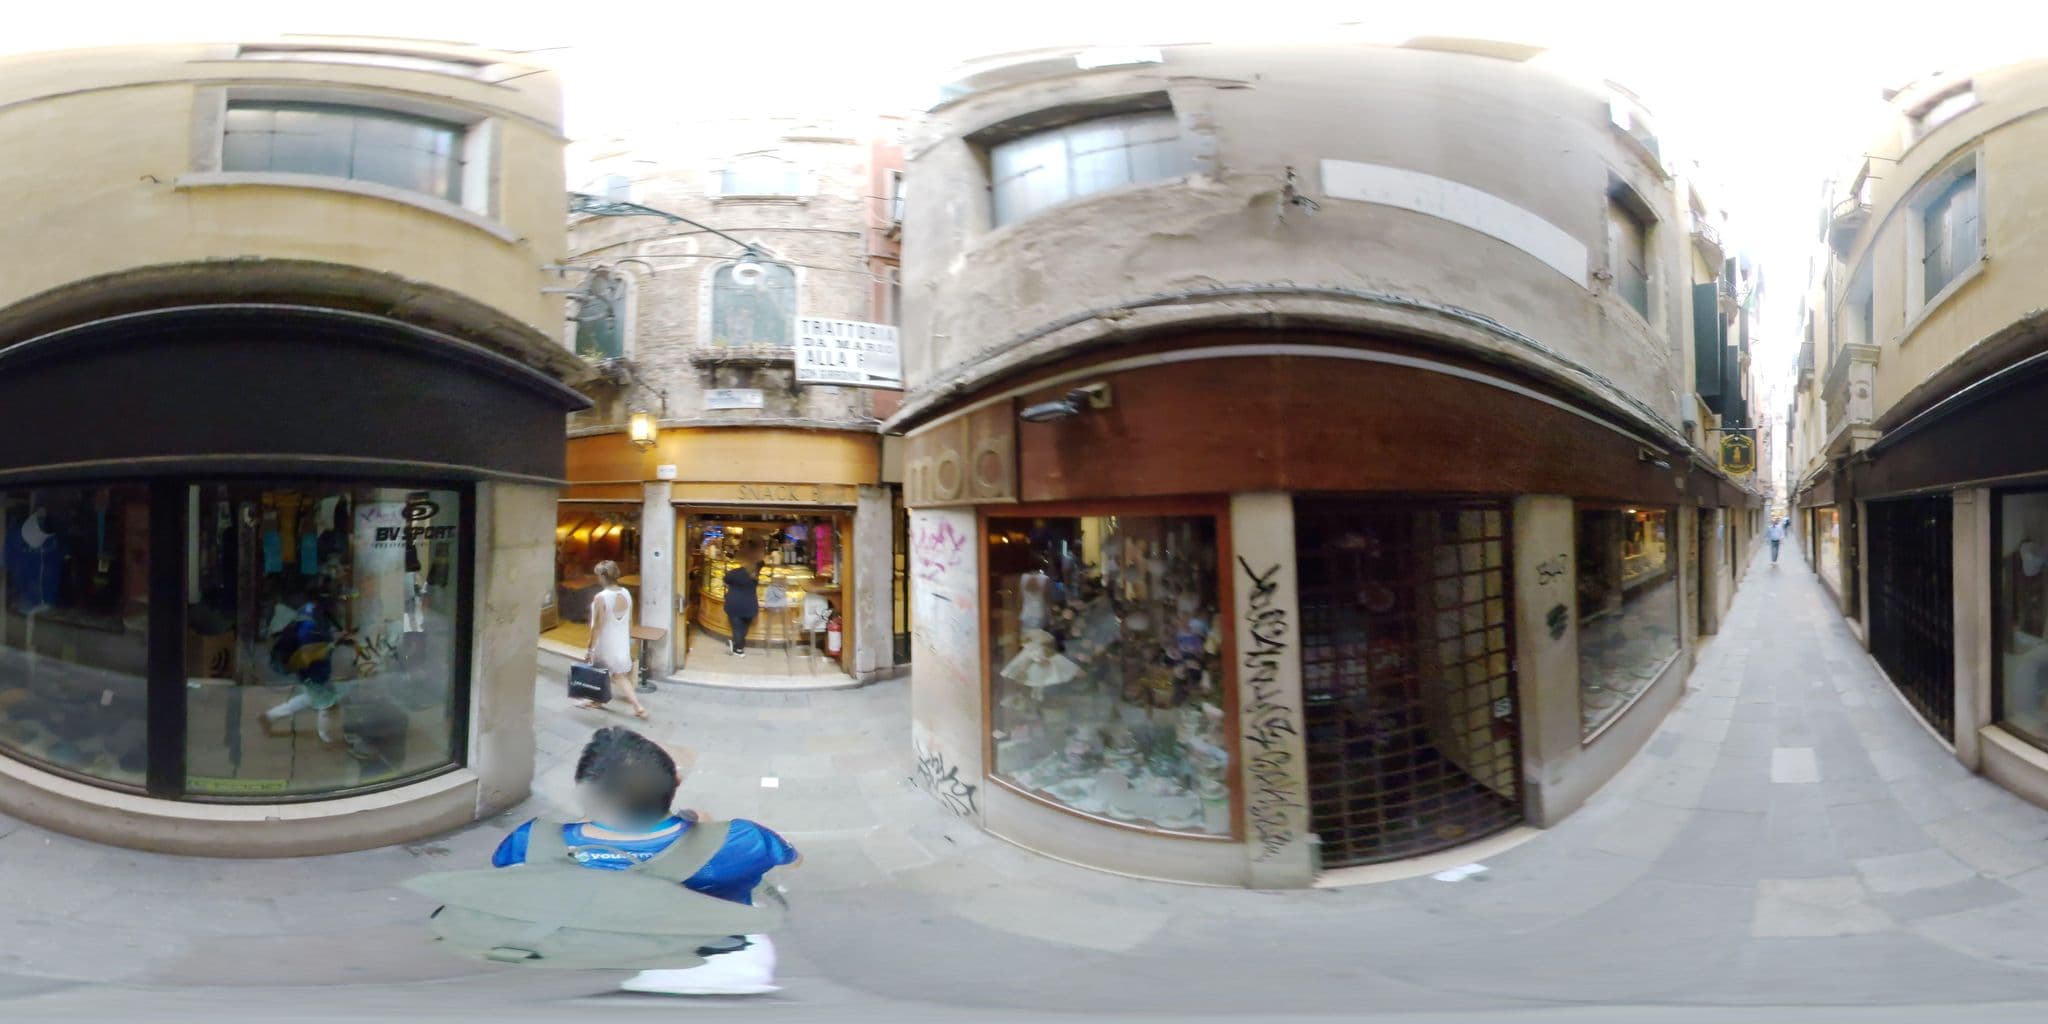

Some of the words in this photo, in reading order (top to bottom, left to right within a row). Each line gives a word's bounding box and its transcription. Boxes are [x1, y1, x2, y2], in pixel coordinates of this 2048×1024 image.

[801, 320, 894, 340] TRATTORIA
[802, 337, 827, 348] DA
[806, 349, 848, 368] ALLA
[737, 484, 800, 502] SNACK
[376, 527, 400, 541] BV
[401, 526, 457, 540] SPORT
